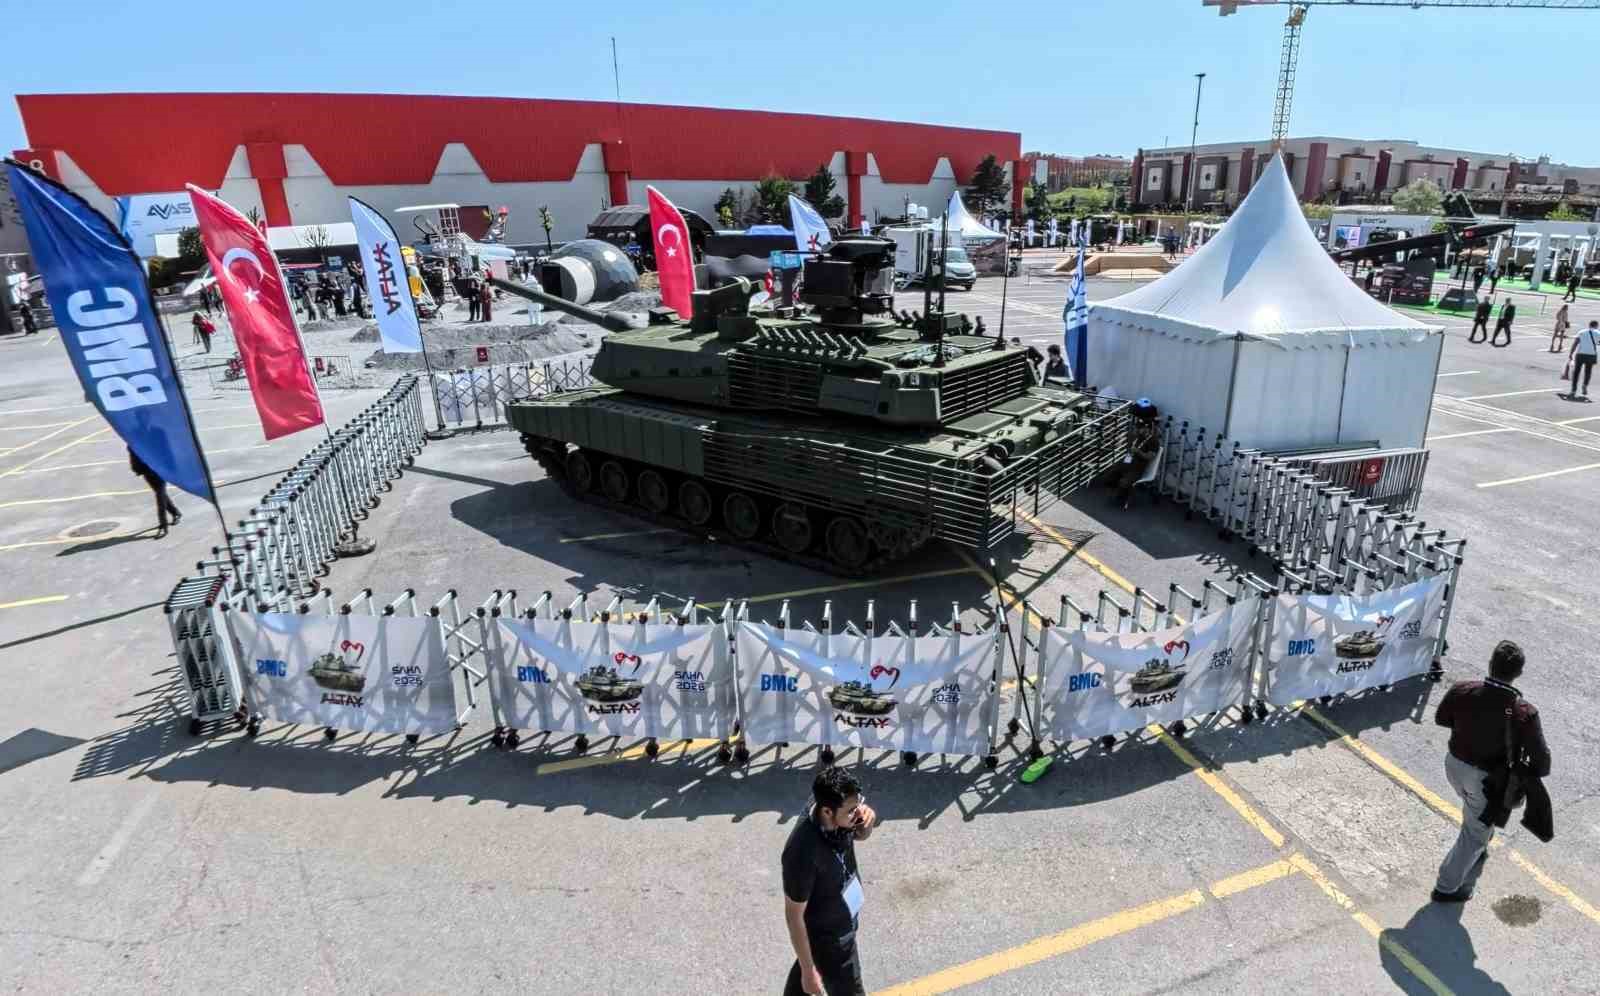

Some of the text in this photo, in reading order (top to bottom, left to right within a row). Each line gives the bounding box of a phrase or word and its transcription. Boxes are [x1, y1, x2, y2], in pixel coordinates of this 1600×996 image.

[1288, 638, 1316, 656] BMC
[256, 659, 287, 677] BMC
[518, 665, 551, 684] BMC
[761, 674, 798, 693] BMC
[1069, 672, 1101, 692] BMC
[320, 692, 364, 708] ALTAY
[588, 702, 641, 715] ALTAY
[1129, 691, 1177, 708] ALTAY
[834, 714, 890, 729] ALTAY
